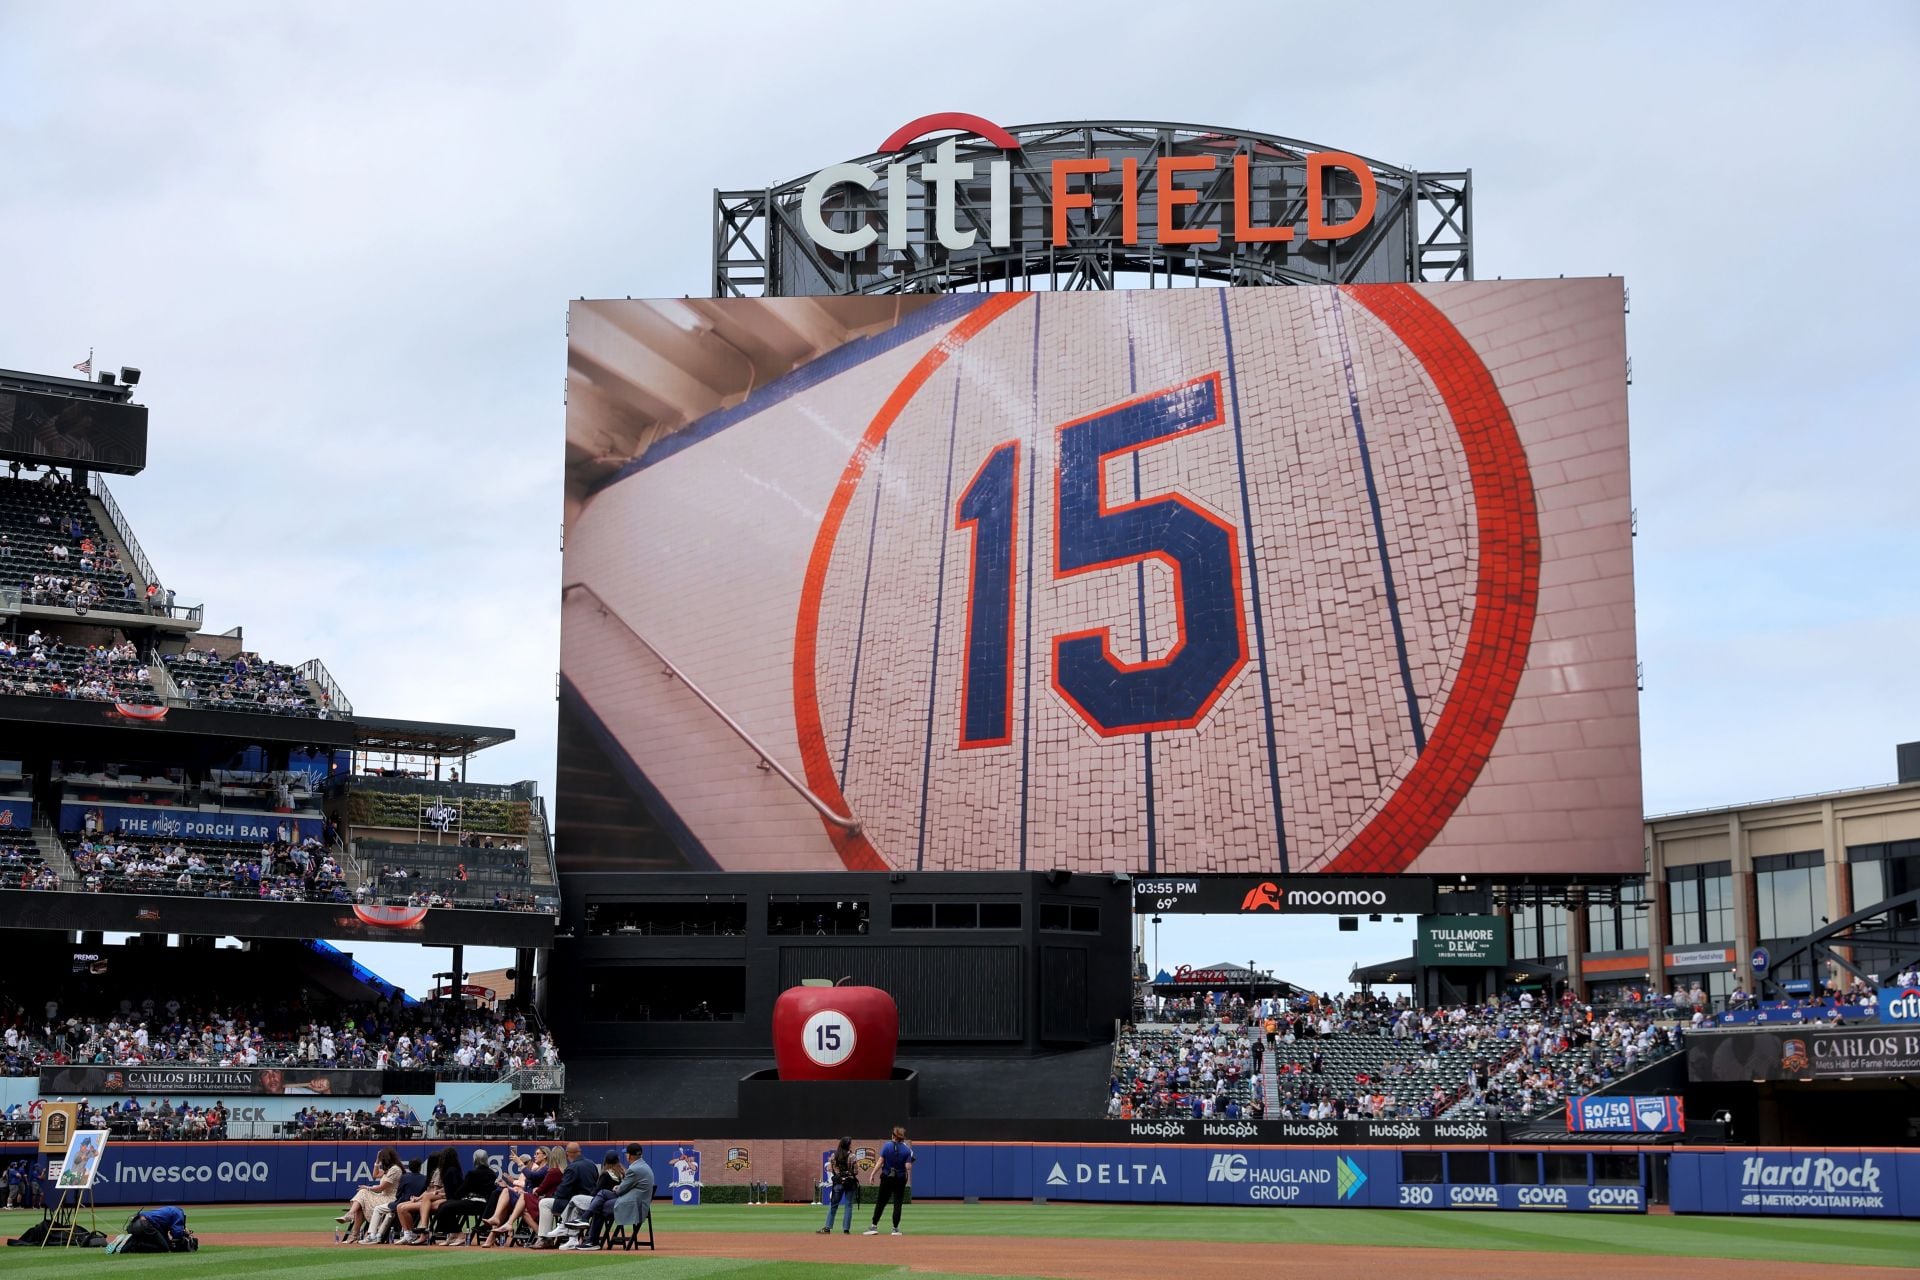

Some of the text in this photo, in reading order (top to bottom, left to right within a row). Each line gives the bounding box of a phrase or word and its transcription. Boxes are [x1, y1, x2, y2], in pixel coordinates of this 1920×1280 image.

[801, 136, 1378, 252] citi FIELD
[955, 371, 1250, 750] 15
[119, 811, 269, 838] THE milagro PORCH BAR
[1137, 883, 1197, 894] 03:55 PM
[1156, 897, 1178, 910] 69°
[1288, 890, 1387, 905] moomoo
[1430, 929, 1494, 940] TULLAMORE
[73, 953, 99, 961] PREMIO
[816, 1024, 841, 1051] 15
[1813, 1037, 1899, 1058] CARLOS
[1816, 1060, 1834, 1069] Mets
[1835, 1059, 1850, 1069] Hall
[1851, 1059, 1859, 1068] of
[1860, 1059, 1883, 1068] Fame
[128, 1071, 252, 1084] CARLOS BELTRÁN
[1584, 1102, 1630, 1117] 50/50
[1131, 1121, 1185, 1137] HubSpot
[1204, 1121, 1259, 1138] HubSpot
[1283, 1121, 1339, 1138] HubSpot
[1369, 1121, 1421, 1139] HubSpot
[1434, 1122, 1488, 1139] HubSpot
[1585, 1116, 1631, 1129] RAFFLE
[115, 1160, 269, 1183] Invesco QQQ
[310, 1161, 411, 1183] CHA
[1076, 1163, 1167, 1185] DELTA
[1207, 1153, 1248, 1182] HG
[1249, 1168, 1331, 1183] HAUGLAND
[1742, 1157, 1880, 1193] Hard Rock
[1249, 1185, 1300, 1200] GROUP
[1400, 1186, 1433, 1204] 380
[1451, 1187, 1498, 1203] GOYA
[1518, 1187, 1567, 1204] GOYA
[1588, 1188, 1639, 1205] GOYA
[1761, 1194, 1884, 1208] METROPOLITAN PARK
